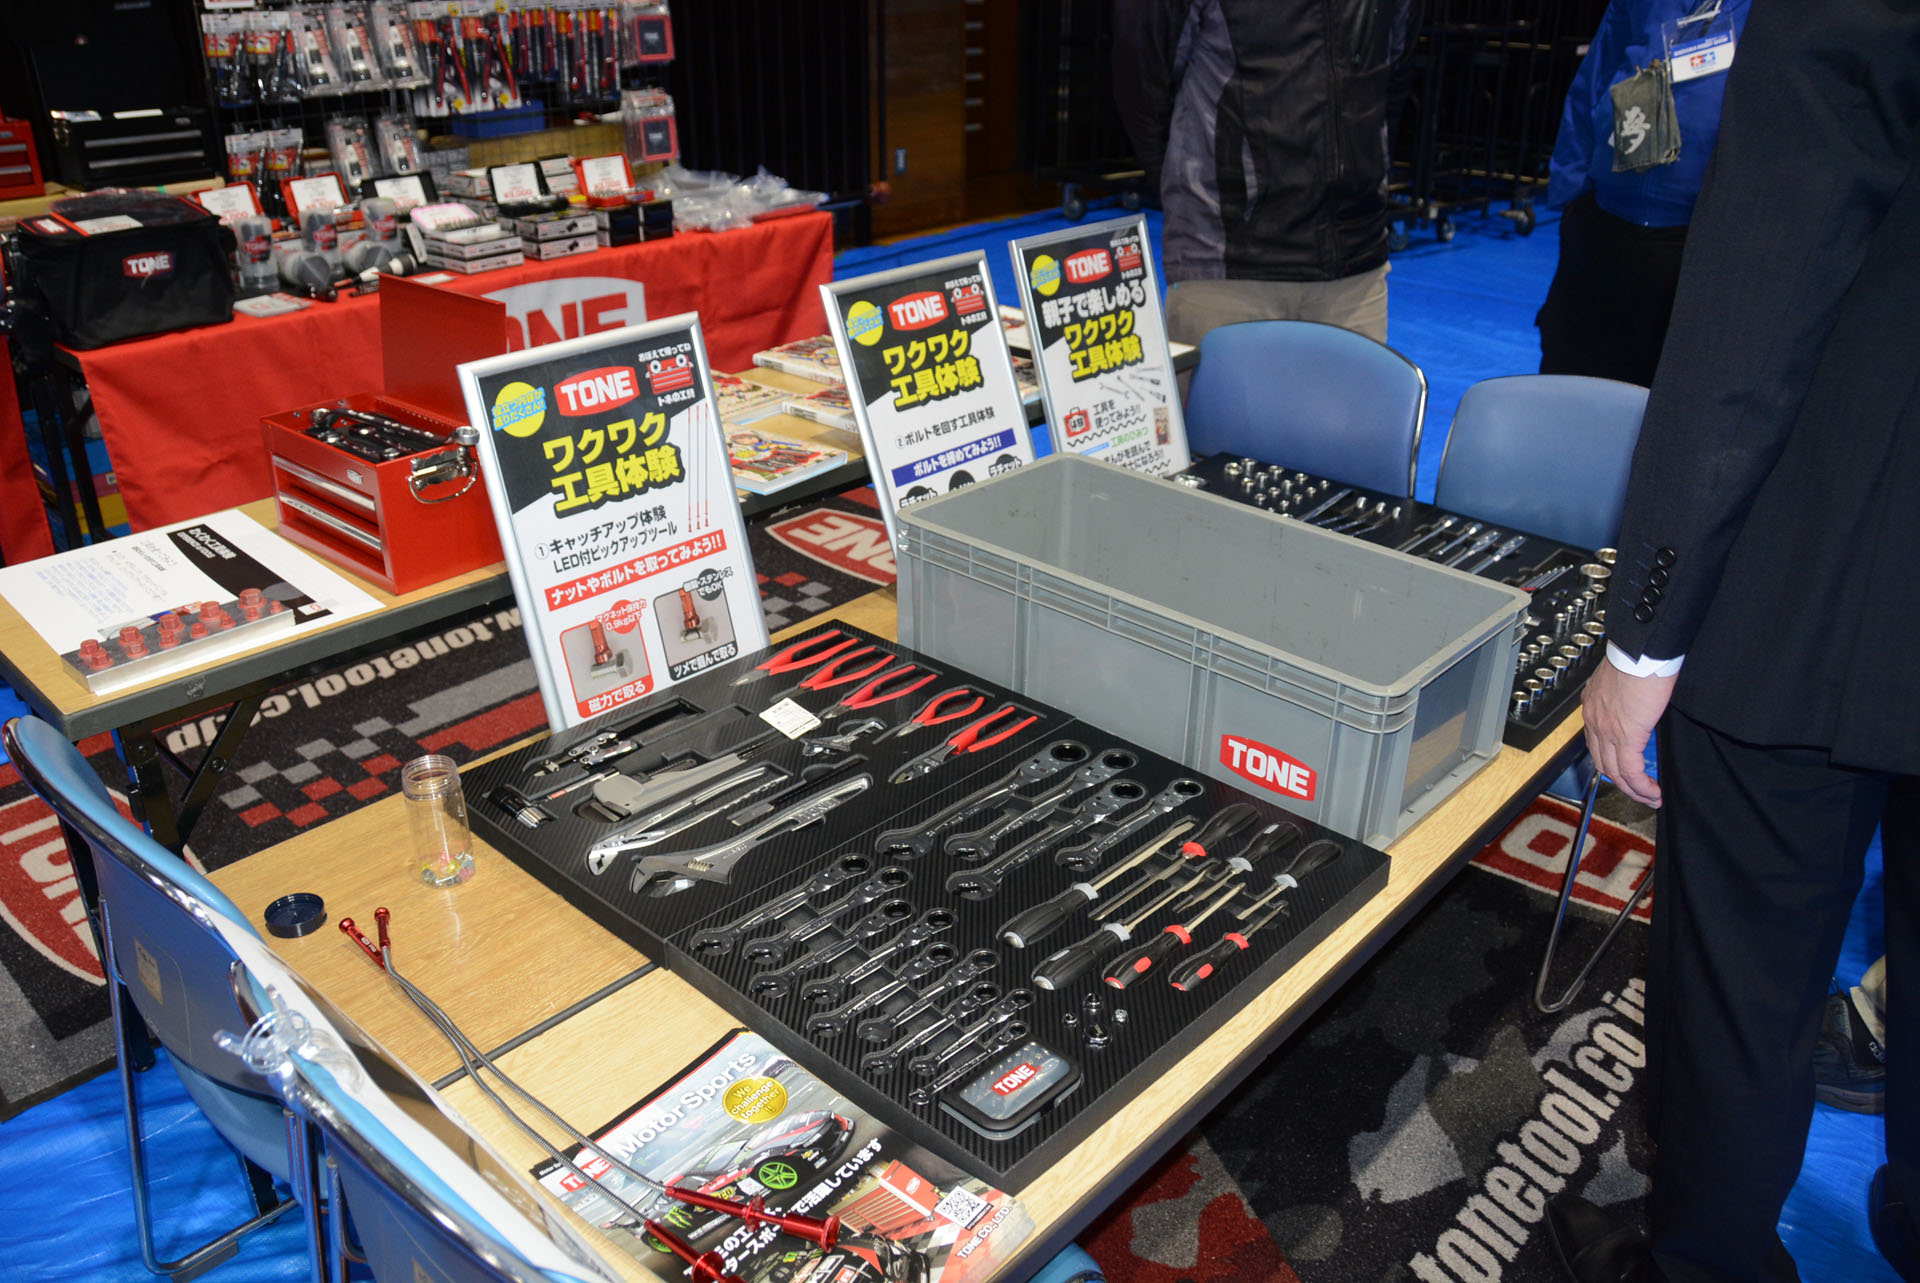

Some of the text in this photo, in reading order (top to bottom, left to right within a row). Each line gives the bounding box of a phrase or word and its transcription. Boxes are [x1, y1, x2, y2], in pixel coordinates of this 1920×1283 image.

[127, 254, 170, 274] TONE
[1068, 252, 1109, 280] TONE
[892, 295, 945, 327] TONE
[1041, 279, 1144, 329] 親子で楽しめる
[1064, 309, 1134, 350] ワクワク
[883, 329, 968, 376] ワクワク
[1069, 334, 1142, 379] 工具体験
[560, 370, 634, 411] TONE
[890, 356, 981, 407] 工具体験
[542, 412, 666, 472] ワクワク
[551, 444, 680, 512] 工具体験
[553, 521, 678, 573] LED付ピックアップツール
[588, 681, 646, 713] 磁力で取る
[1228, 738, 1310, 797] TONE
[730, 1079, 774, 1116] challenge
[733, 1084, 752, 1099] We
[994, 1064, 1035, 1093] TONE
[613, 1052, 757, 1158] Motor Sports
[741, 1088, 781, 1120] together
[562, 1159, 611, 1190] TNE
